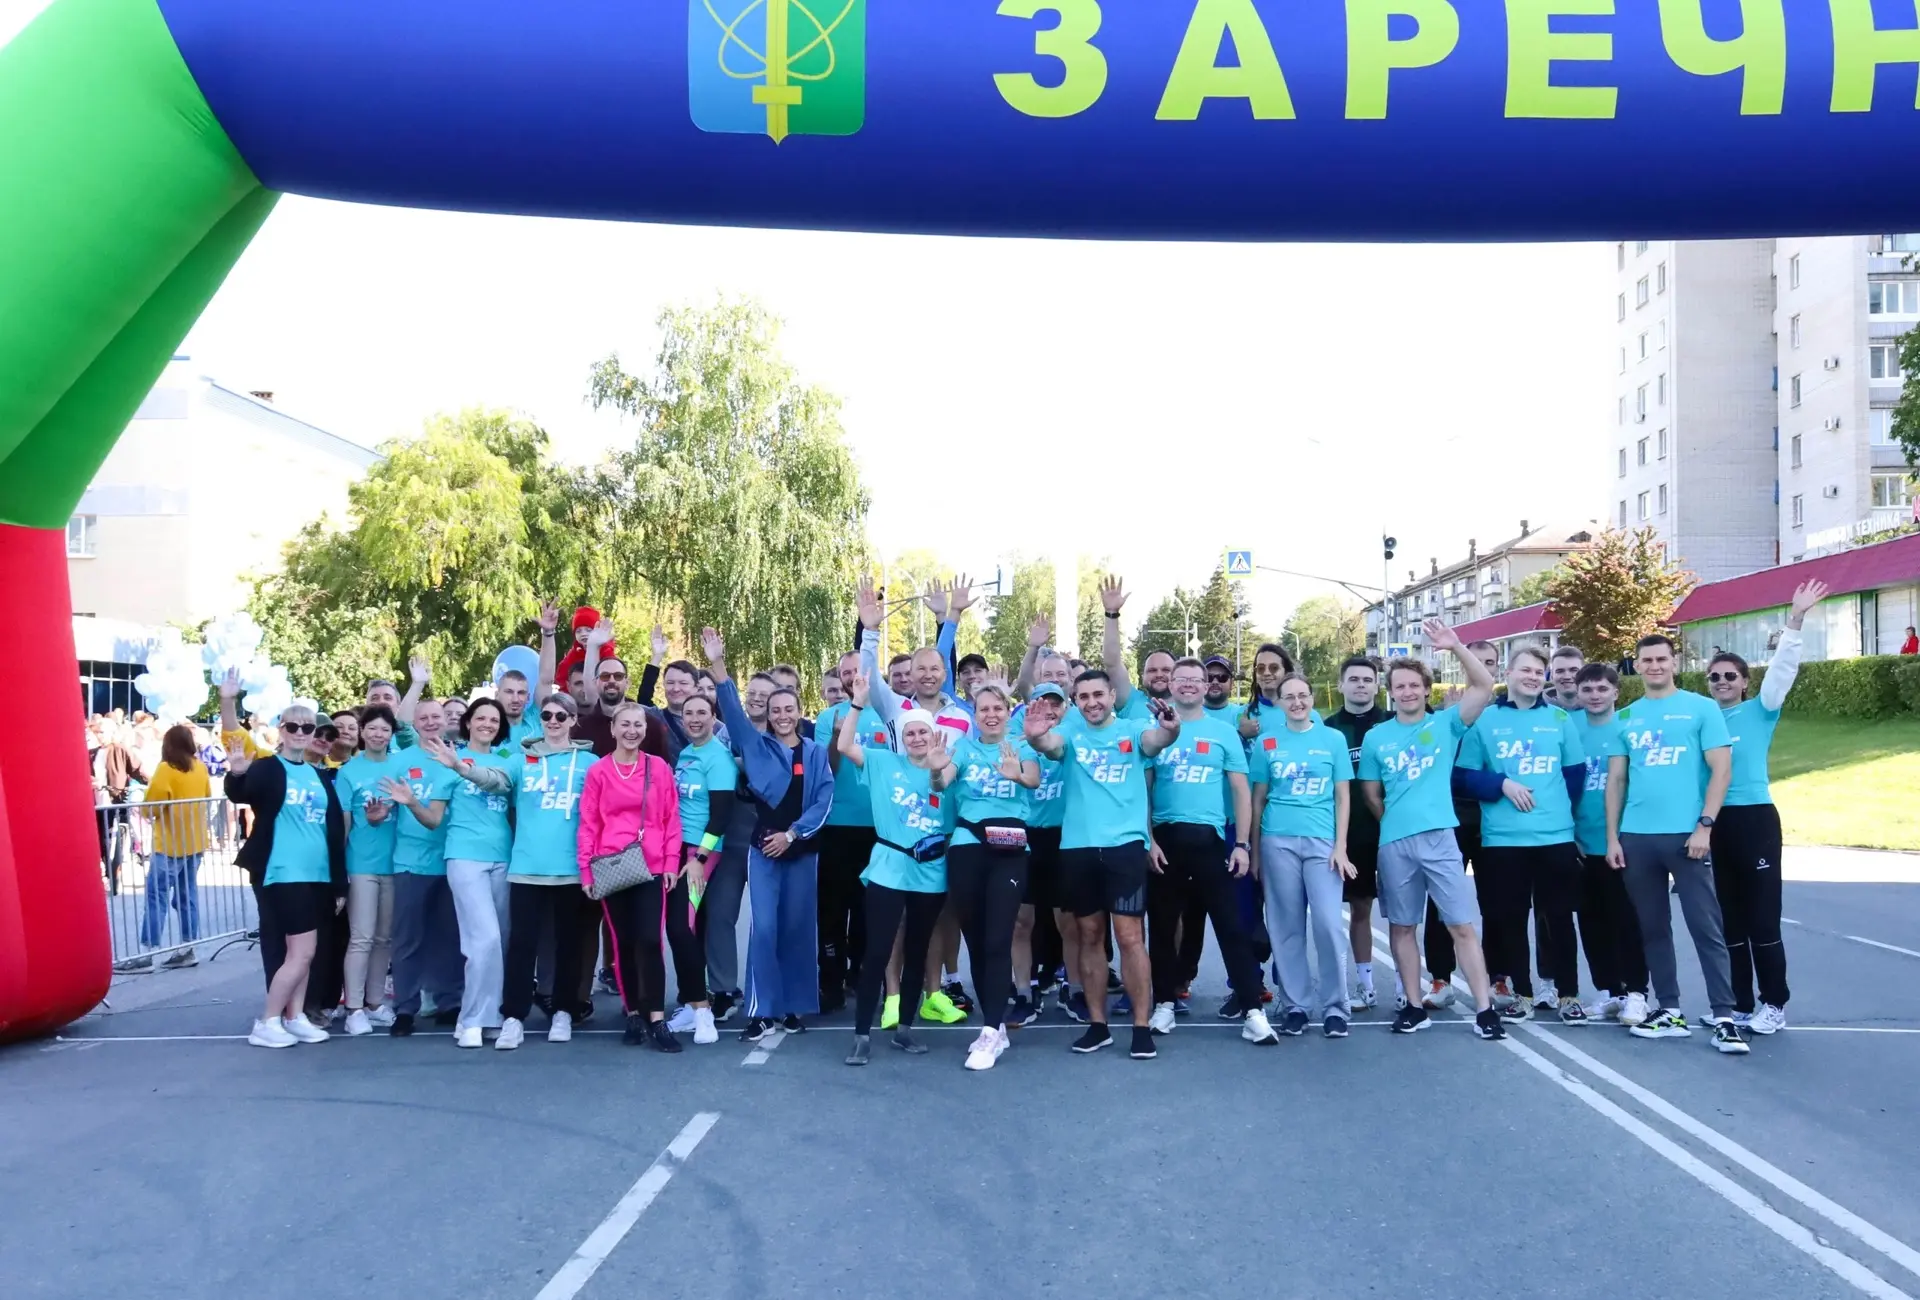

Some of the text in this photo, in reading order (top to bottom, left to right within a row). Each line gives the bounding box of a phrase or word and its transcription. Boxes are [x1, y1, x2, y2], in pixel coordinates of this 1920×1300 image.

[1518, 756, 1558, 775] БЕГ
[1645, 747, 1687, 766] БЕГ
[1093, 763, 1132, 783] БЕГ
[1174, 765, 1214, 783] БЕГ
[1290, 777, 1330, 795] БЕГ
